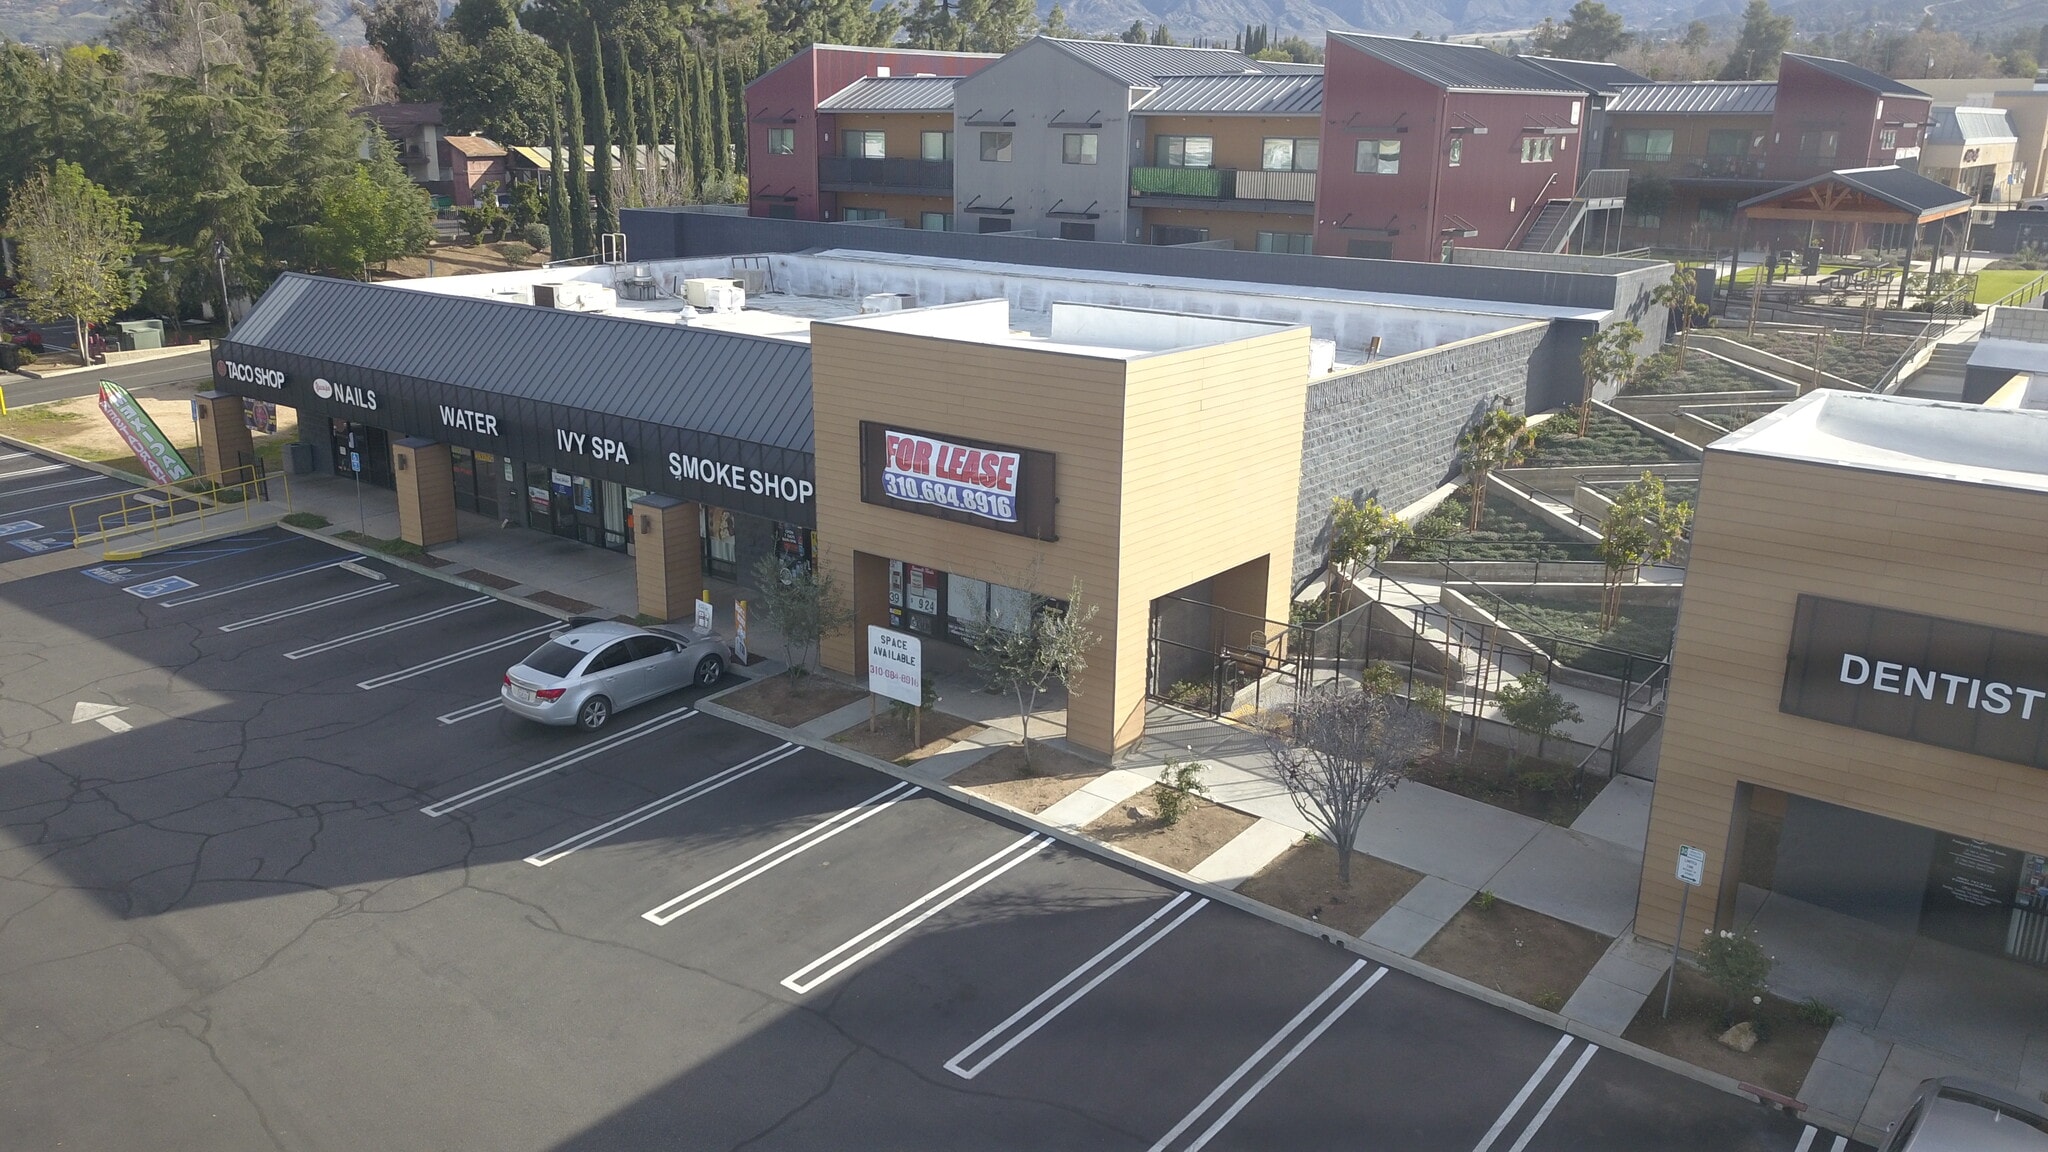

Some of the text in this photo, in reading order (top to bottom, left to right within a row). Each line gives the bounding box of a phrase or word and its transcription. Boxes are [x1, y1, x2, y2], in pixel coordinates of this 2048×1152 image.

[225, 361, 285, 389] TACO SHOP
[333, 382, 377, 410] NAILS
[439, 405, 499, 437] WATER
[557, 428, 630, 465] IVY SPA
[886, 435, 1015, 492] FOR LEASE
[669, 452, 814, 504] SMOKE SHOP
[884, 473, 1013, 518] 310.684.8916
[873, 646, 916, 667] AVAILABLE
[880, 634, 908, 650] SPACE
[1839, 653, 2046, 720] DENTIST
